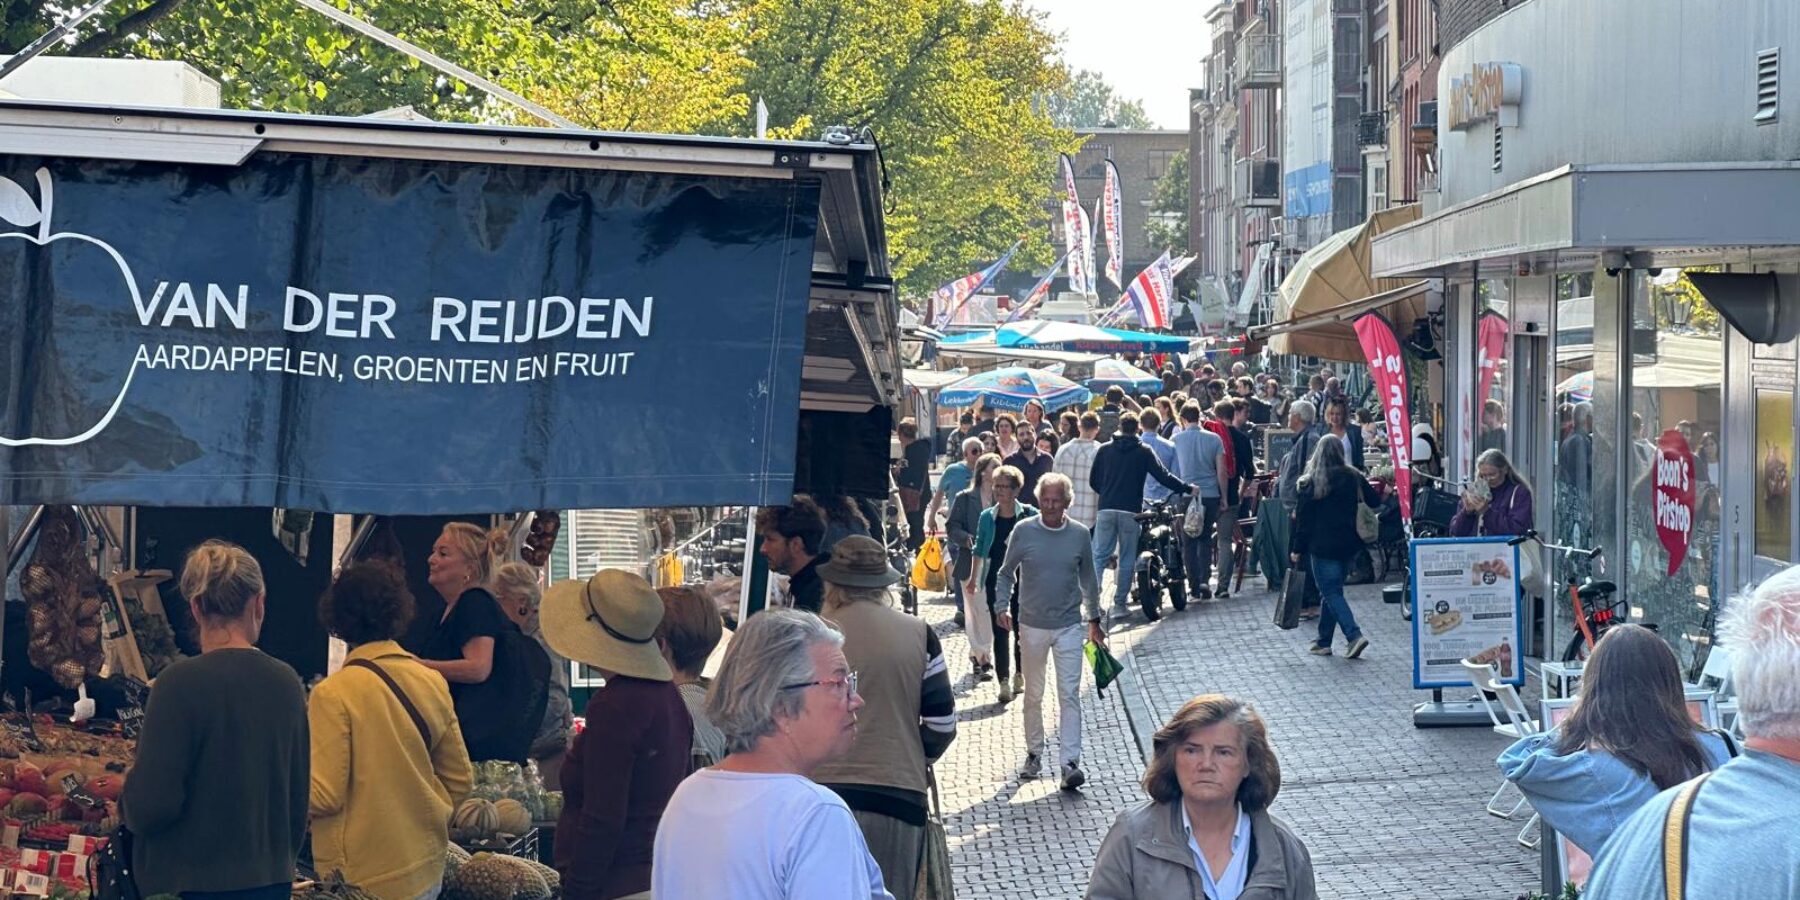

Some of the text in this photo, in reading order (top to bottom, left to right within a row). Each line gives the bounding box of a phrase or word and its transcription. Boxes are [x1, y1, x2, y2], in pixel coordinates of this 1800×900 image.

[131, 281, 653, 343] VAN DER REIJDEN
[134, 343, 634, 384] AARDAPPELEN, GROENTEN EN FRUIT
[1657, 449, 1689, 492] Boon's
[1657, 489, 1690, 545] Pitstop
